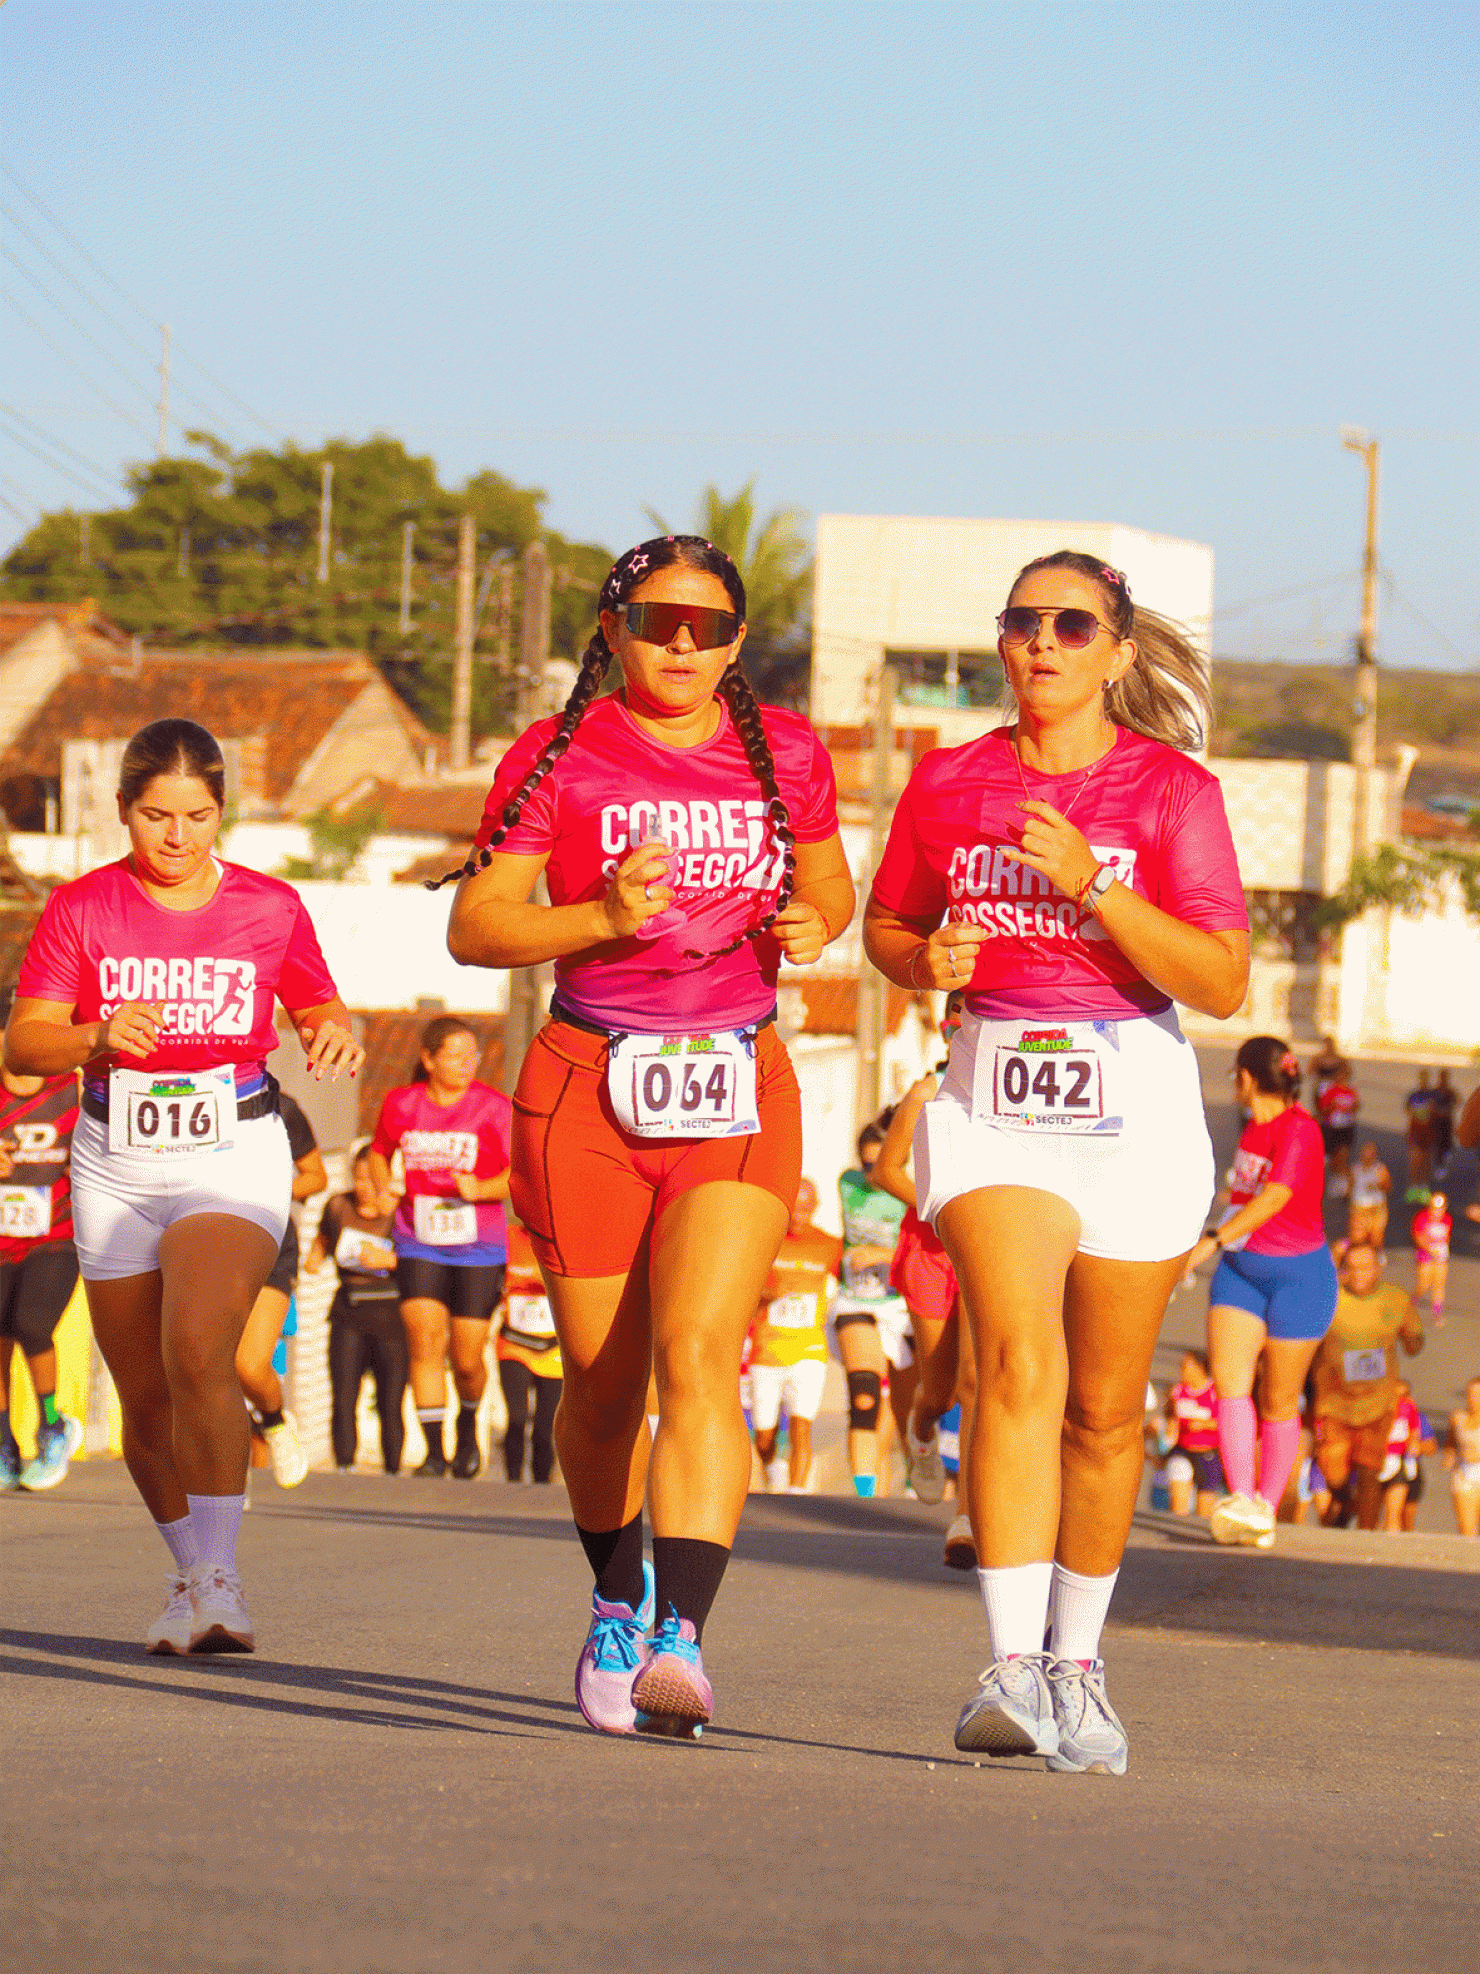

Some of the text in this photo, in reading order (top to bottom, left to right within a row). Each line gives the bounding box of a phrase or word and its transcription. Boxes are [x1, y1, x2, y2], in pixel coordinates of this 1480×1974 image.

[601, 800, 748, 854] CORRE
[602, 853, 748, 889] SEGO
[947, 844, 1067, 898] CORR
[99, 957, 214, 1001] CORRE
[99, 1002, 214, 1035] SEGO
[643, 1063, 727, 1112] 064
[1003, 1056, 1092, 1108] 042
[137, 1100, 211, 1138] 016
[1036, 1116, 1073, 1125] SECTEJ
